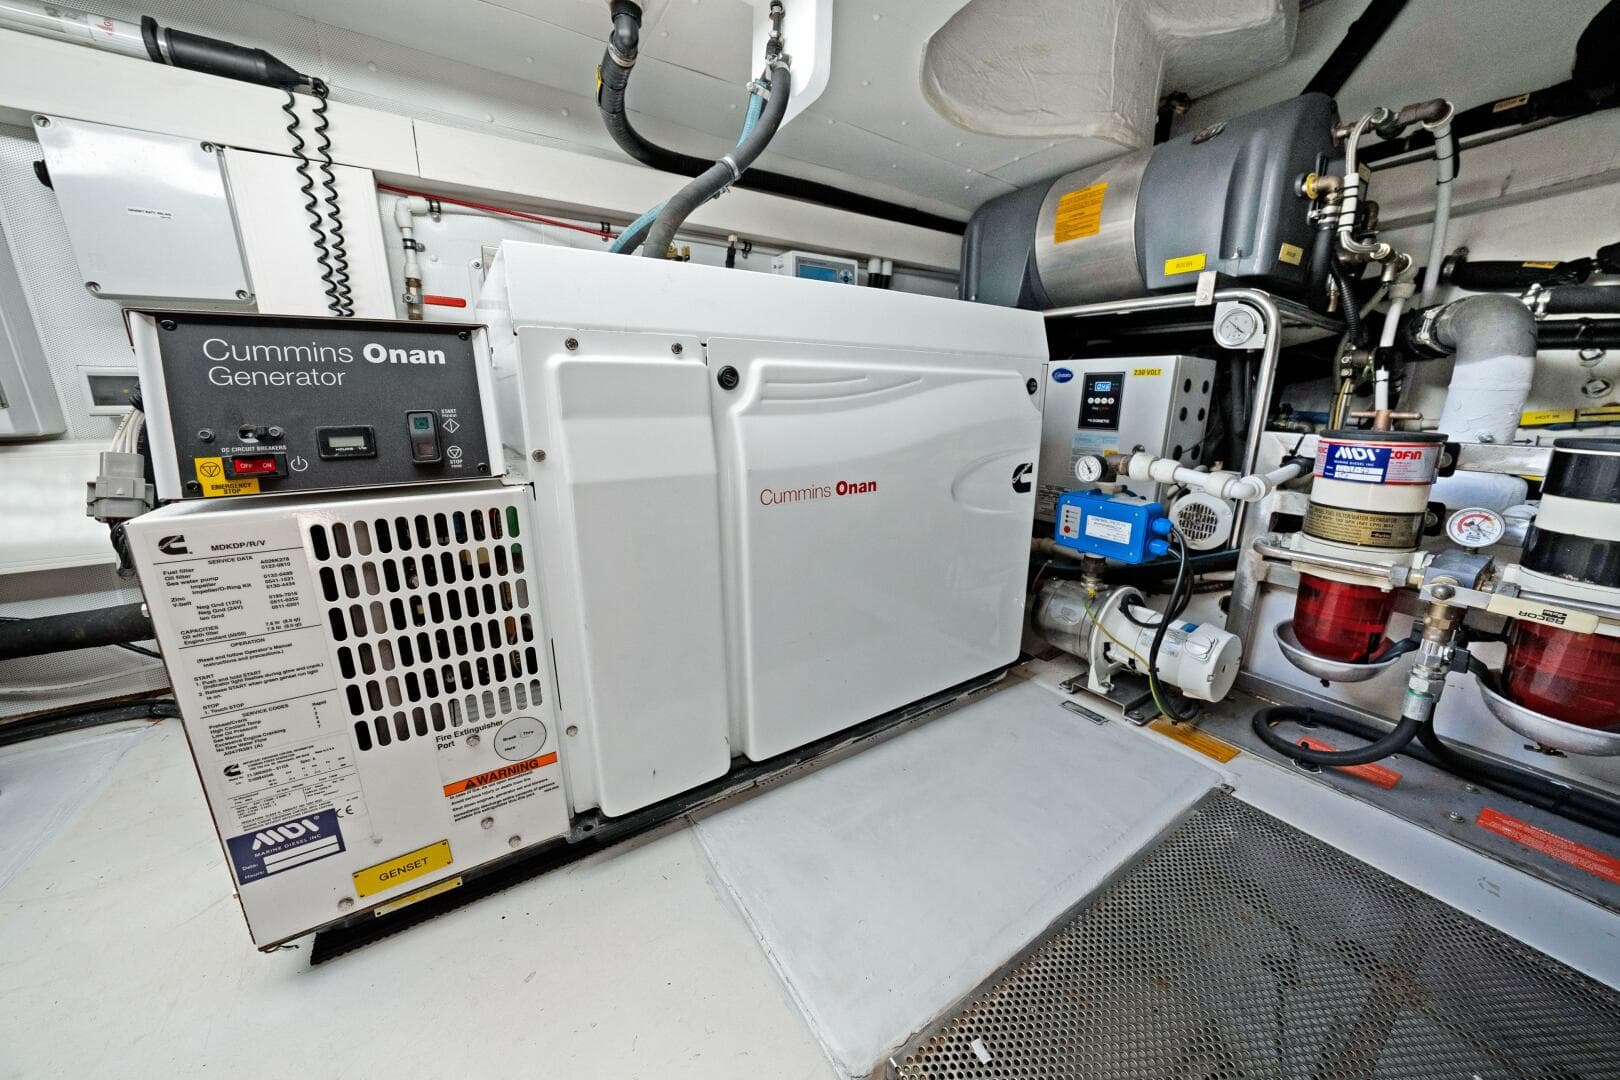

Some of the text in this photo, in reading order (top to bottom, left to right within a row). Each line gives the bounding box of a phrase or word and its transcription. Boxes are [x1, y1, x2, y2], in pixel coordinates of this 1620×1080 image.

[202, 338, 446, 365] Cummins Onan
[208, 365, 346, 386] Generator
[1335, 447, 1376, 461] MDI
[760, 480, 877, 505] Cummins Onan
[211, 540, 266, 551] MDKDP/R/V
[208, 557, 236, 565] SERVICE
[200, 576, 219, 584] pump
[192, 585, 242, 595] Impeller/O-Ring
[227, 604, 244, 612] (24V)
[180, 625, 219, 635] CAPACITIES
[228, 631, 247, 639] (50/50)
[230, 638, 265, 648] OPERATION
[197, 656, 214, 664] (Read
[244, 647, 273, 656] Operator's
[249, 650, 284, 660] precautions.)
[242, 670, 261, 678] START
[203, 681, 230, 690] (Indicator
[244, 674, 264, 682] flashes
[242, 704, 289, 717] SERVICE CODES
[209, 718, 248, 729] Preheat/Crank
[234, 726, 257, 734] Pressure
[435, 720, 504, 743] Fire Extinguisher
[215, 739, 242, 748] Excessive
[263, 729, 286, 737] Cranking
[225, 733, 245, 741] Manual
[238, 740, 254, 748] Water
[437, 741, 455, 750] Port
[476, 760, 539, 785] WARNING
[501, 782, 512, 790] death
[252, 819, 319, 850] MDI
[254, 846, 282, 857] MARINE
[284, 838, 307, 848] DIESEL
[379, 856, 429, 881] GENSET
[244, 870, 265, 879] Hours:
